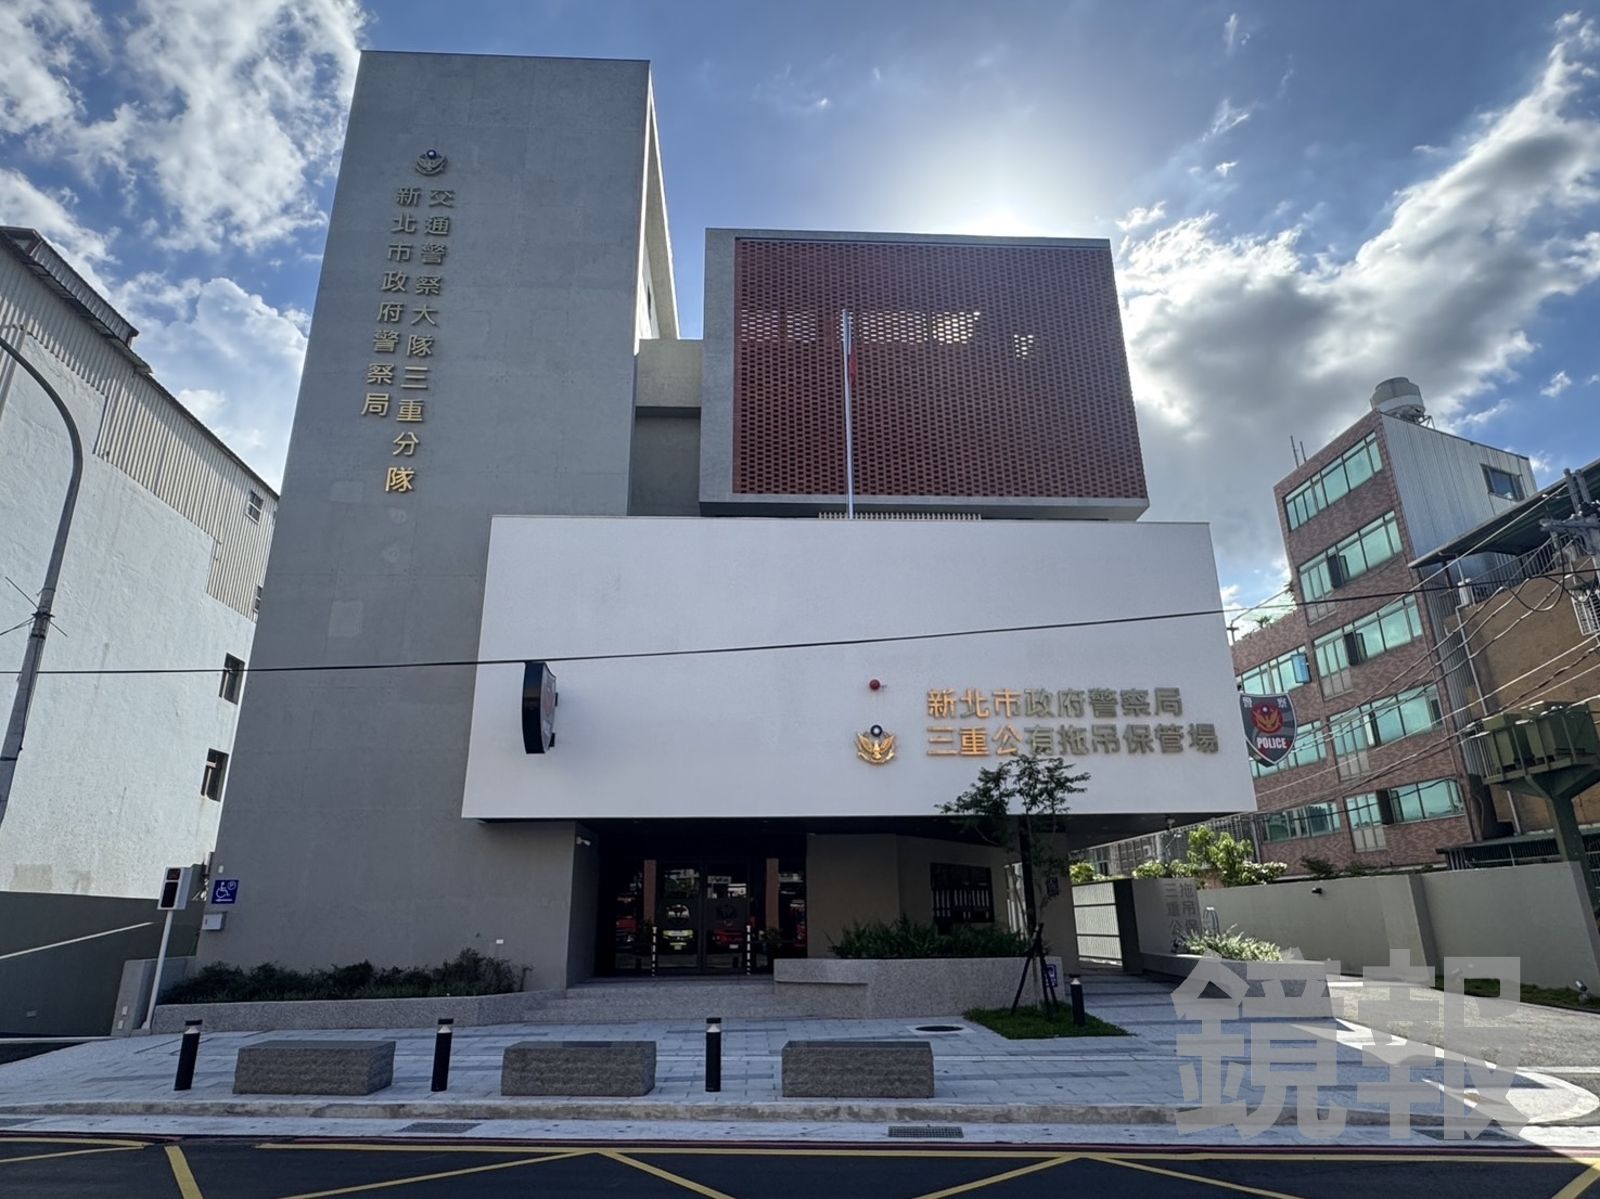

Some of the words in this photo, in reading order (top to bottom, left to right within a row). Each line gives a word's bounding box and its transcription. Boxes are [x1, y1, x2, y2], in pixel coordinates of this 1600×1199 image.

[361, 187, 420, 417] 新北市政府警察局
[385, 188, 455, 493] 交通警察大隊三重分隊
[926, 687, 1183, 718] 新北市政府警察局
[926, 723, 1219, 756] 三重公有拖吊保管場
[1256, 737, 1287, 749] POLICE
